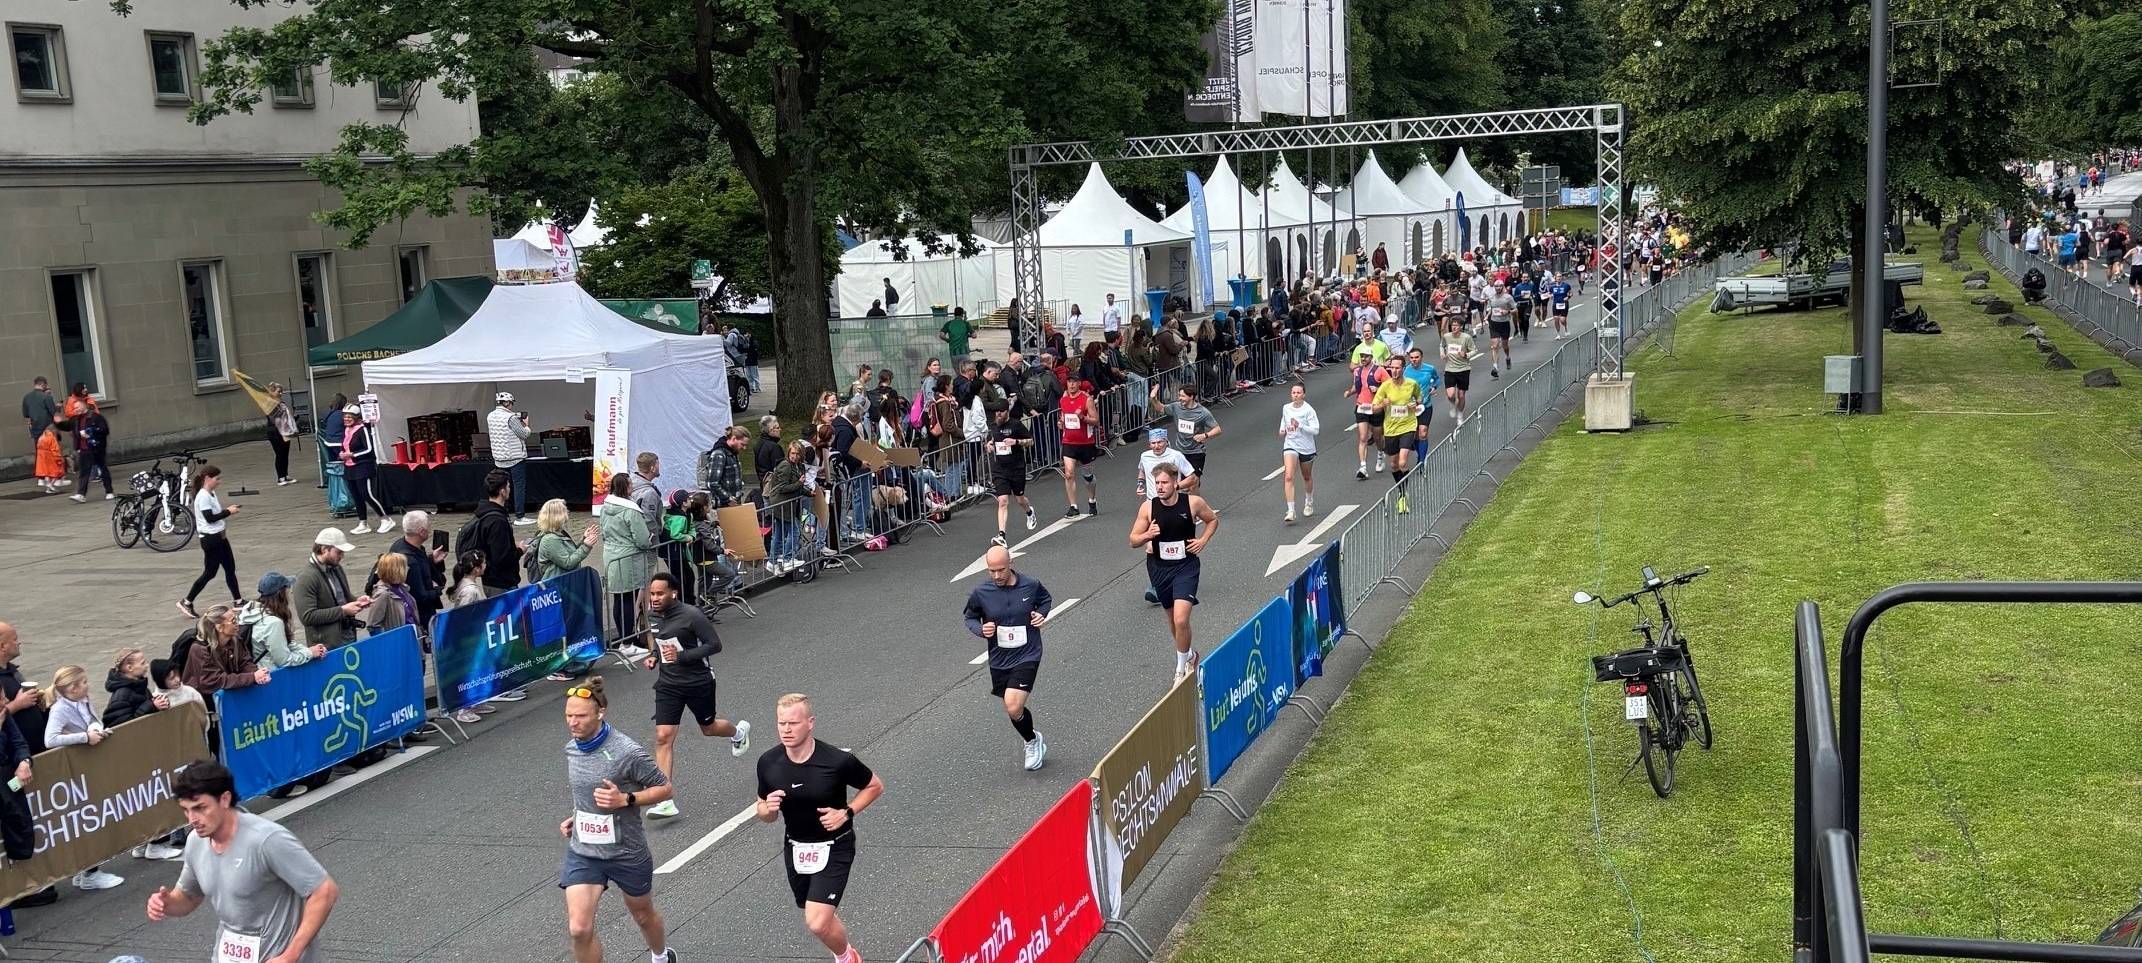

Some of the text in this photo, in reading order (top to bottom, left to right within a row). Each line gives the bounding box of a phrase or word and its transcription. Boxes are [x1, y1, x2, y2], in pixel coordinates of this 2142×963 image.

[607, 396, 617, 457] Kaufmann
[531, 590, 562, 611] RINKE.
[1008, 632, 1014, 641] 9
[233, 695, 351, 750] Läuft bei uns.
[580, 821, 609, 834] 10534
[798, 851, 820, 863] 946
[223, 941, 251, 960] 3338
